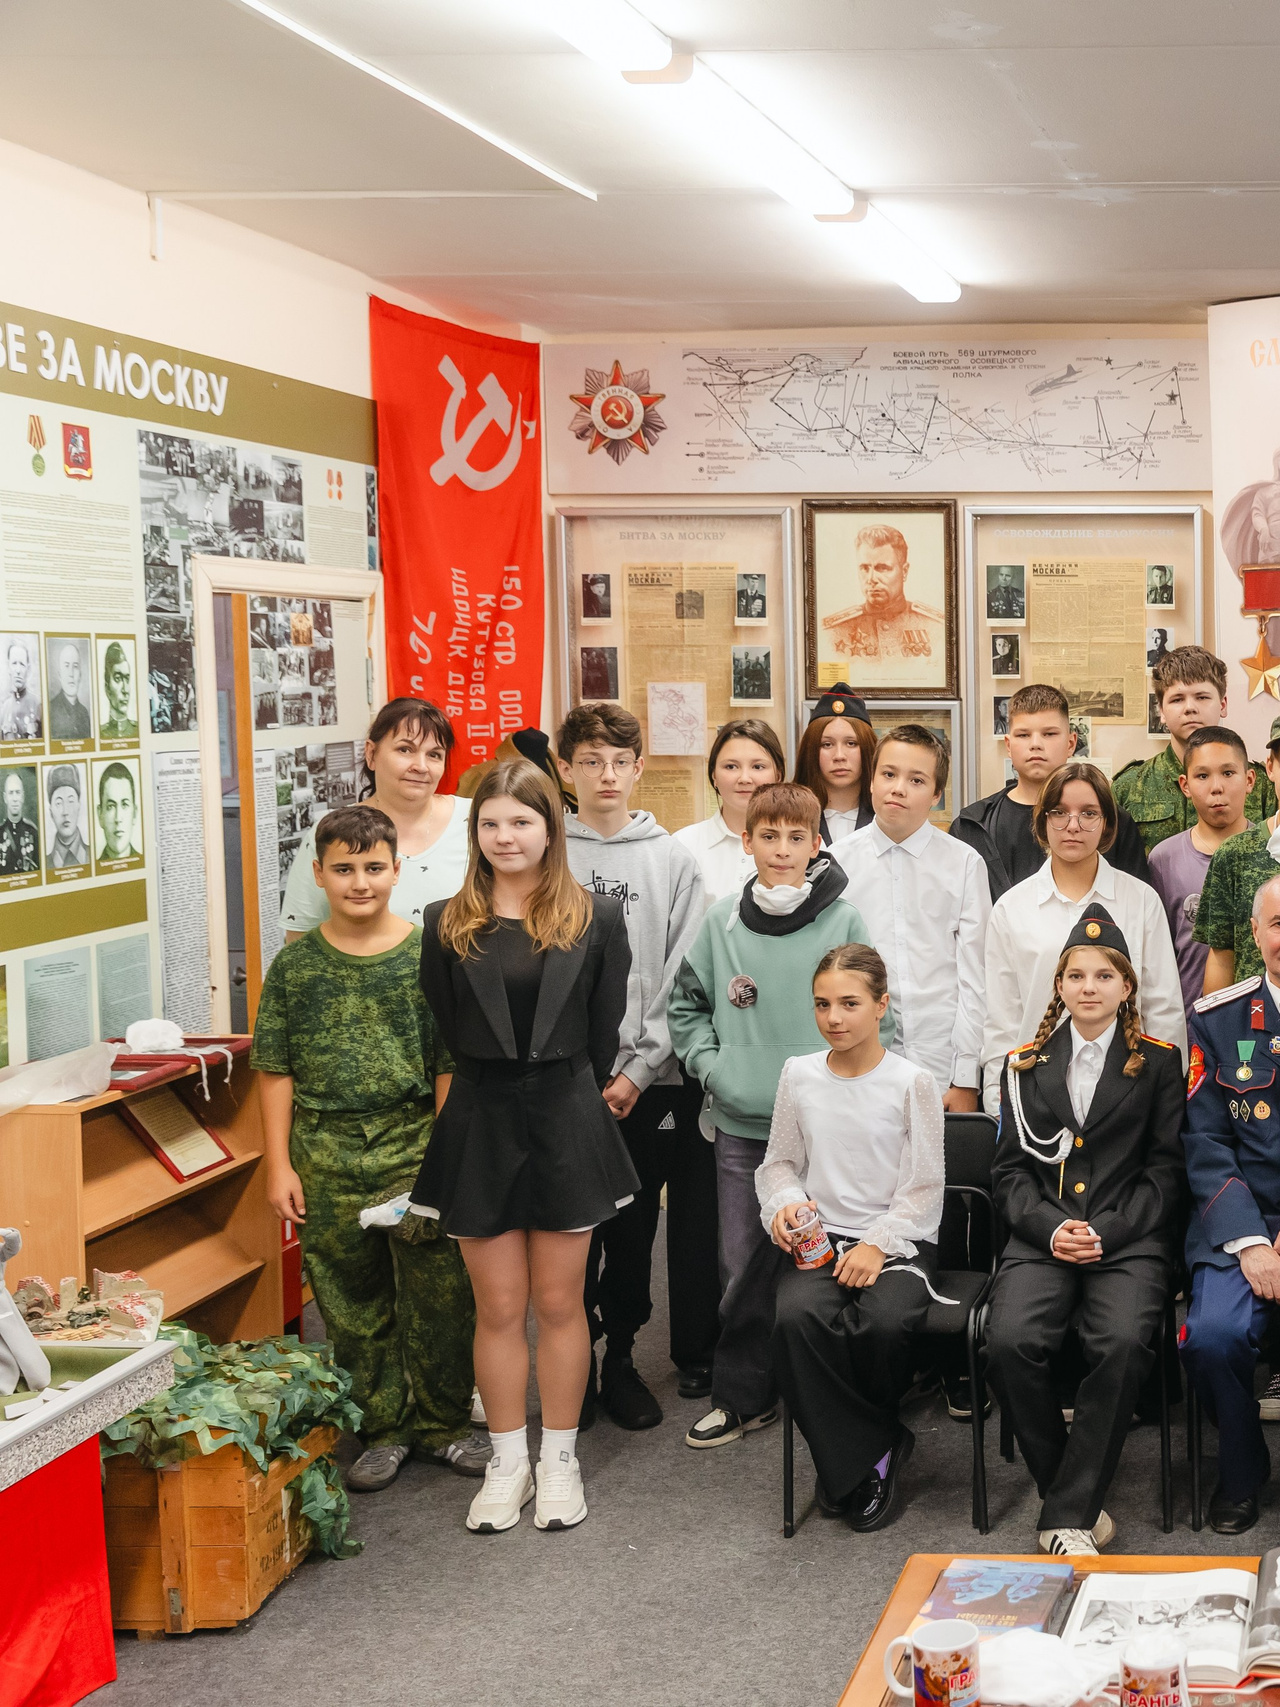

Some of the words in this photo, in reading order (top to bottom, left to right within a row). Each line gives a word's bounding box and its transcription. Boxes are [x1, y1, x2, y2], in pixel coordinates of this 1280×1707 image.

[958, 349, 975, 357] 569
[978, 349, 1037, 357] ШТУРМОВОГО
[896, 358, 960, 366] АВИАЦИОННОГО
[970, 357, 1024, 365] ОСОВЕЦКОГО
[36, 330, 86, 387] ЗА
[93, 345, 229, 417] МОСКВУ
[619, 531, 657, 541] БИТВА
[660, 531, 675, 541] ЗА
[677, 531, 727, 541] МОСКВУ
[993, 528, 1094, 539] ОСВОБОЖДЕНИЕ
[1097, 528, 1175, 539] БЕЛОРУССИИ
[1032, 567, 1066, 575] МОСКВА
[501, 565, 523, 611] 150
[494, 620, 517, 670] СТР.
